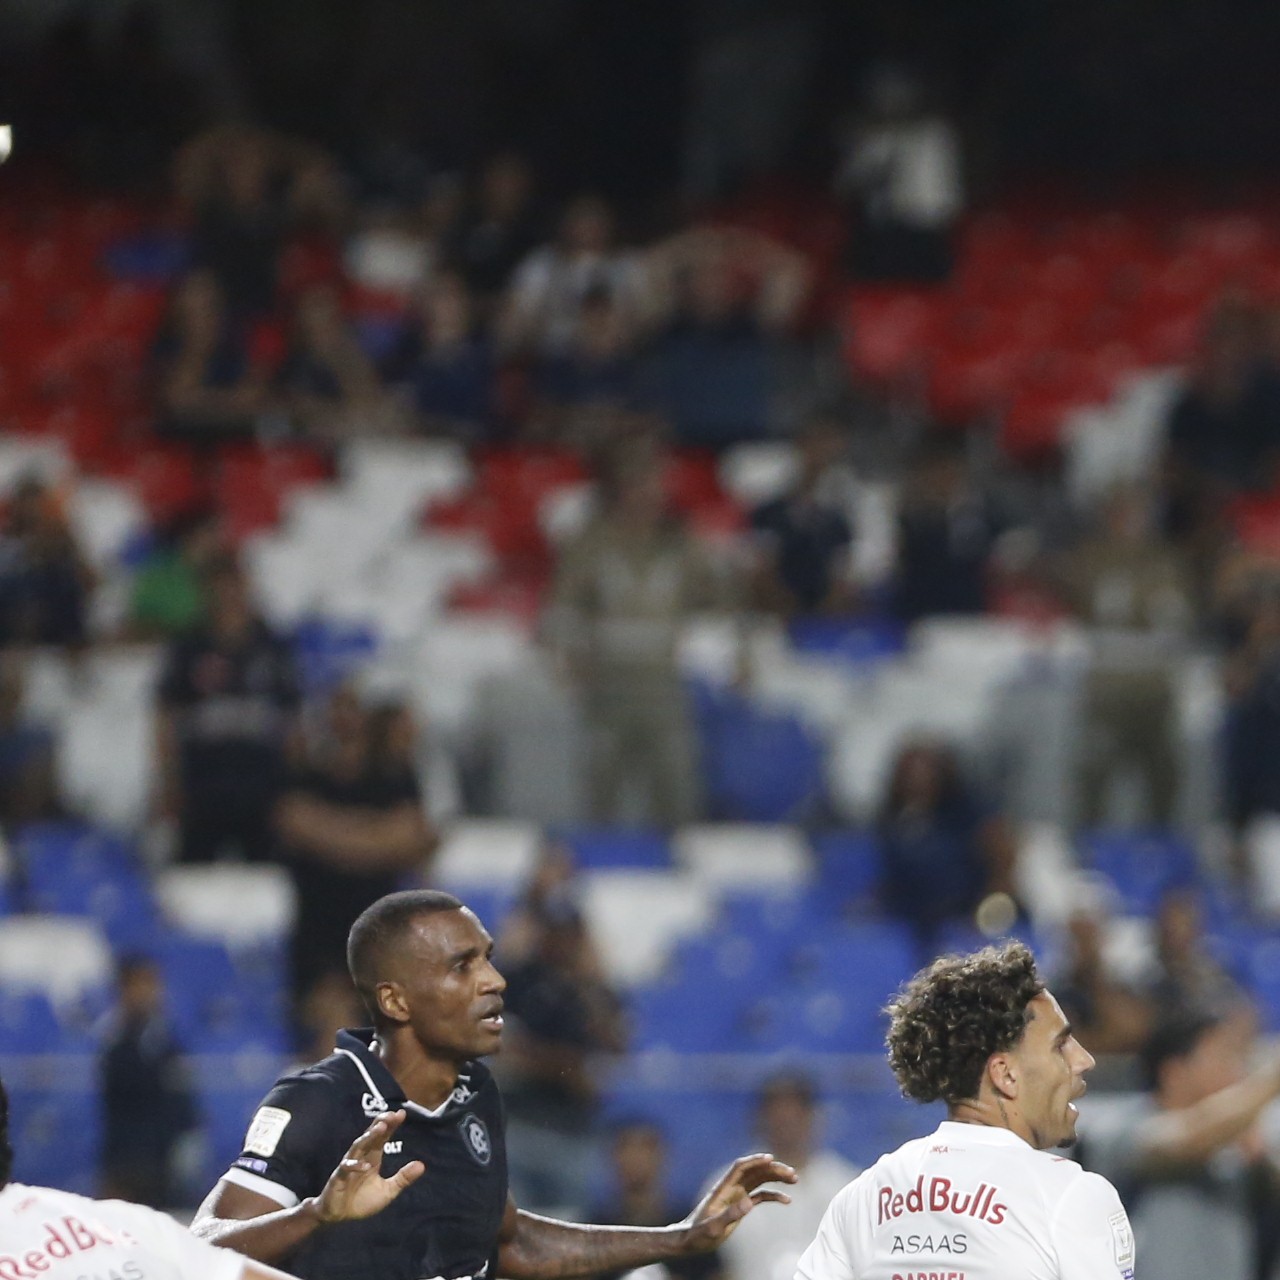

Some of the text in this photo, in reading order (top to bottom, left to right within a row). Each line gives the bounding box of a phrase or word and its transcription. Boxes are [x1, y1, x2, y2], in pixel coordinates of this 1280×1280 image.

[384, 1140, 403, 1154] OLT
[877, 1174, 1008, 1226] Red Bulls
[891, 1233, 968, 1255] ASAAS
